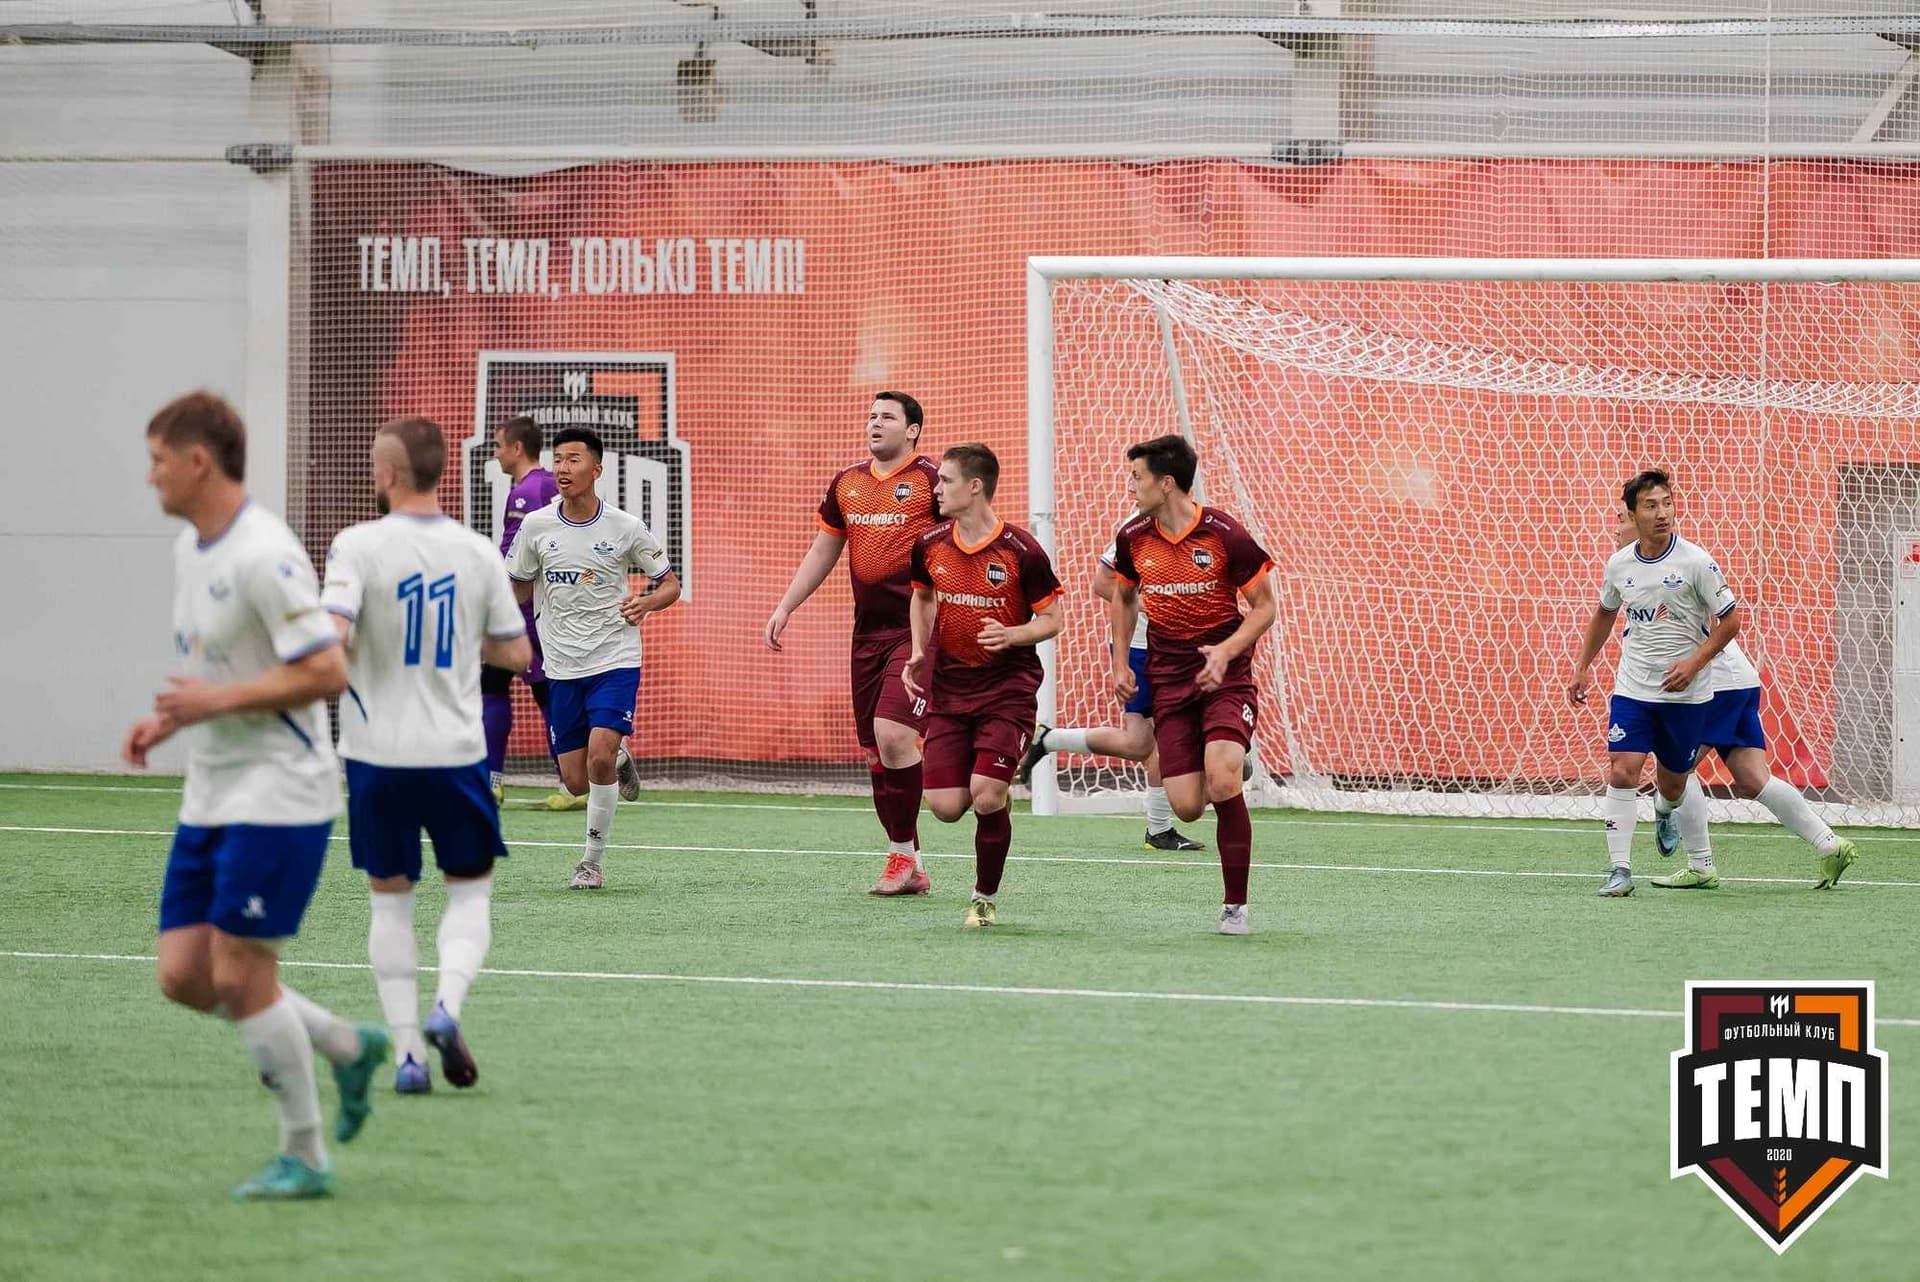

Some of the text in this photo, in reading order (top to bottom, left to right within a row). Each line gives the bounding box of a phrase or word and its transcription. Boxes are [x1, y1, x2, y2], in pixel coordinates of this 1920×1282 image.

[358, 236, 804, 300] ТЕМП, ТЕМП, ТОЛЬКО ТЕМП!
[545, 570, 580, 585] GNV
[397, 572, 455, 668] 11
[912, 696, 927, 717] 13
